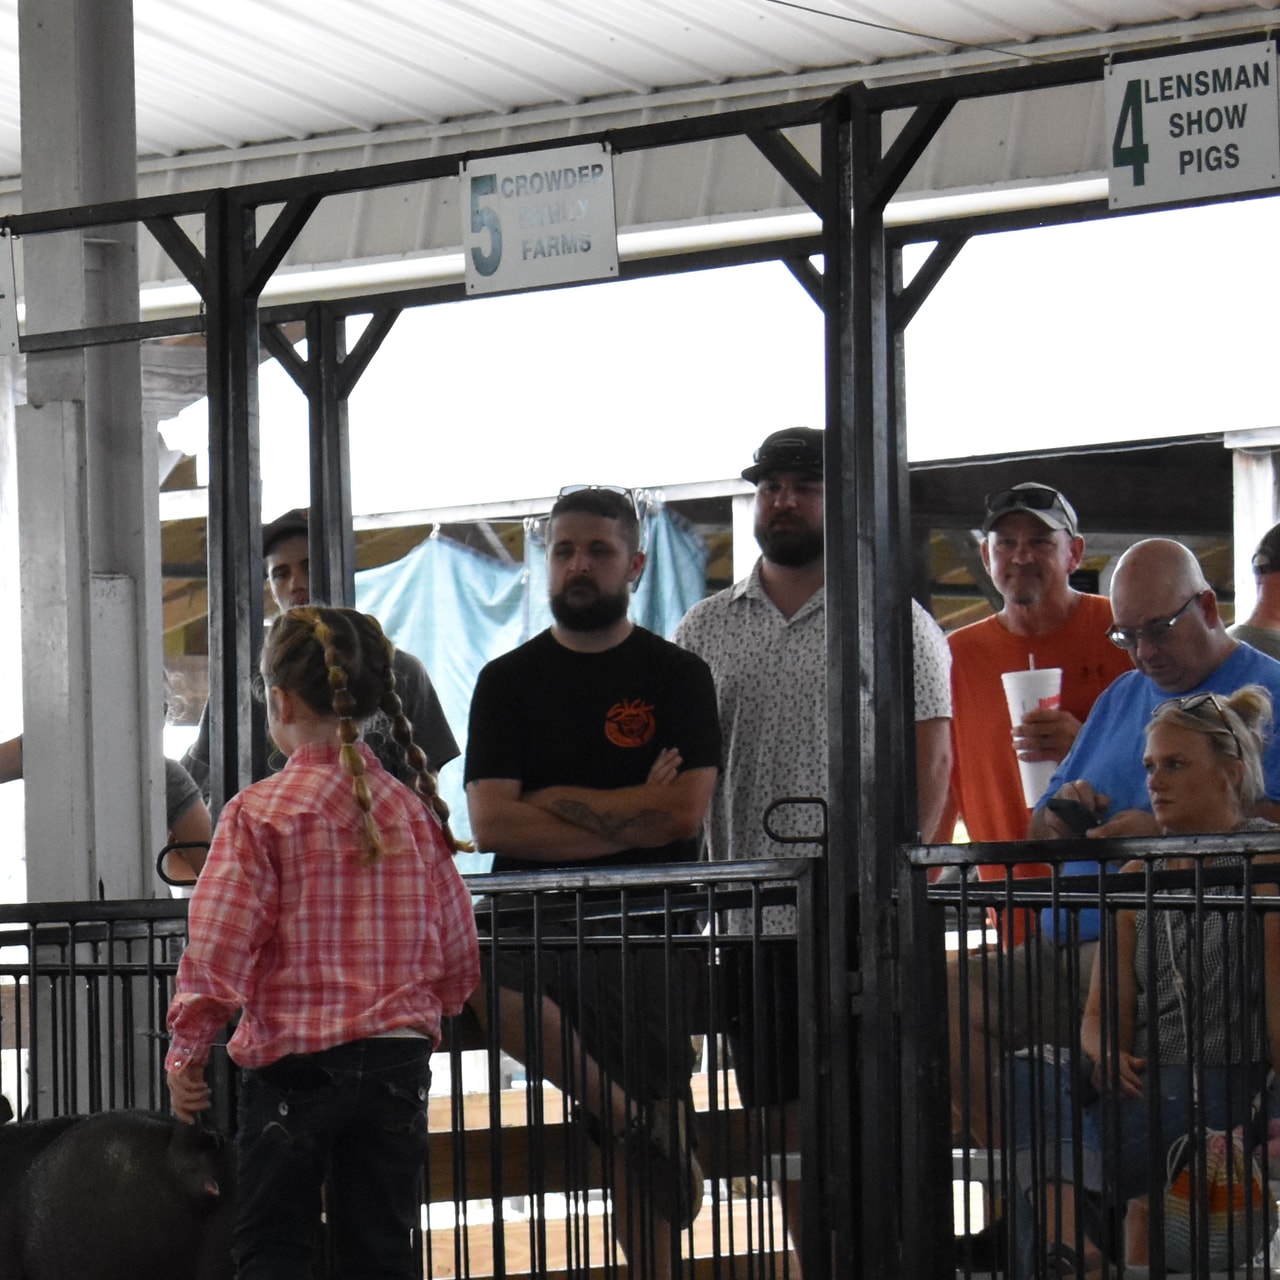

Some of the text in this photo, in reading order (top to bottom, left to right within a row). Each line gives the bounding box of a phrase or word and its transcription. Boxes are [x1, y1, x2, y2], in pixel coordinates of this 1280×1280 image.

[1144, 60, 1270, 104] LENSMAN
[1112, 78, 1149, 187] 4
[1169, 103, 1248, 138] SHOW
[1179, 143, 1240, 175] PIGS
[470, 173, 503, 277] 5
[521, 231, 592, 261] FARMS
